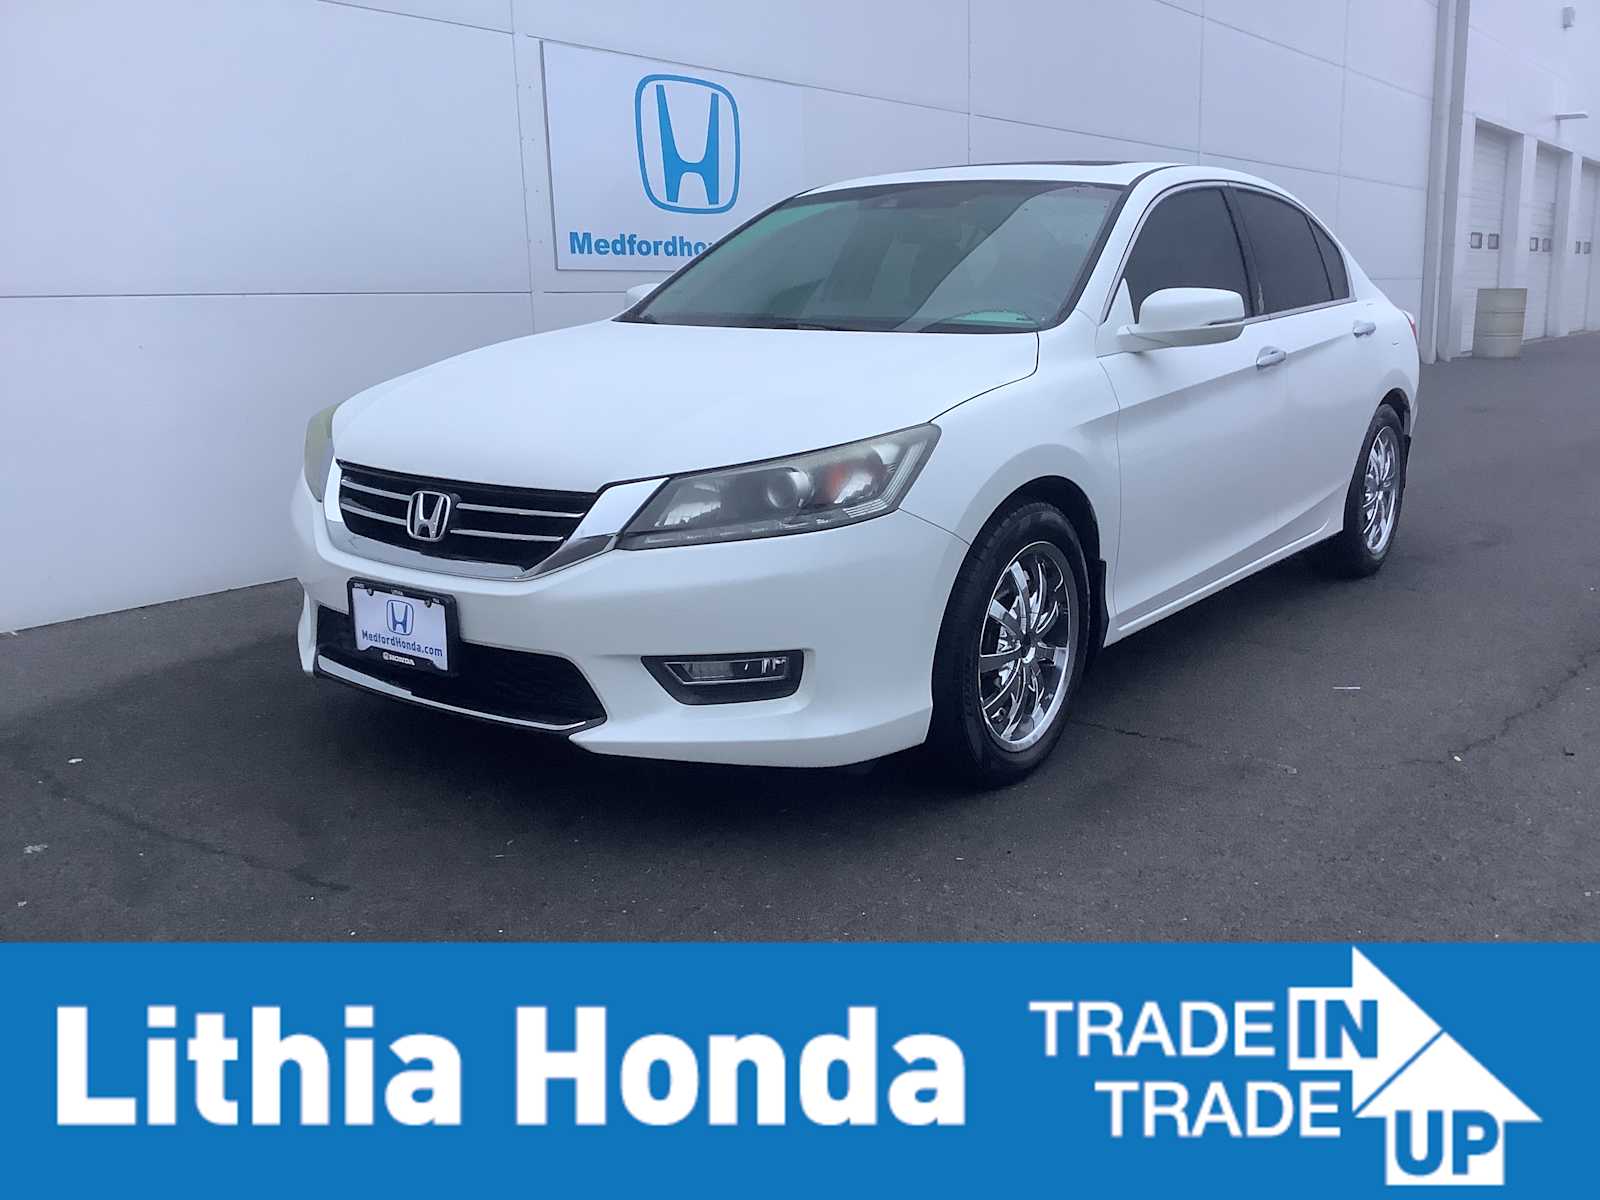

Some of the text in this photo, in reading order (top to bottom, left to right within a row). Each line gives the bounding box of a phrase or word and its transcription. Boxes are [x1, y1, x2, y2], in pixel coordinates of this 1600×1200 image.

[569, 231, 712, 257] Medfordho
[362, 629, 443, 657] MedfordHonda.com
[388, 653, 415, 666] HONDA
